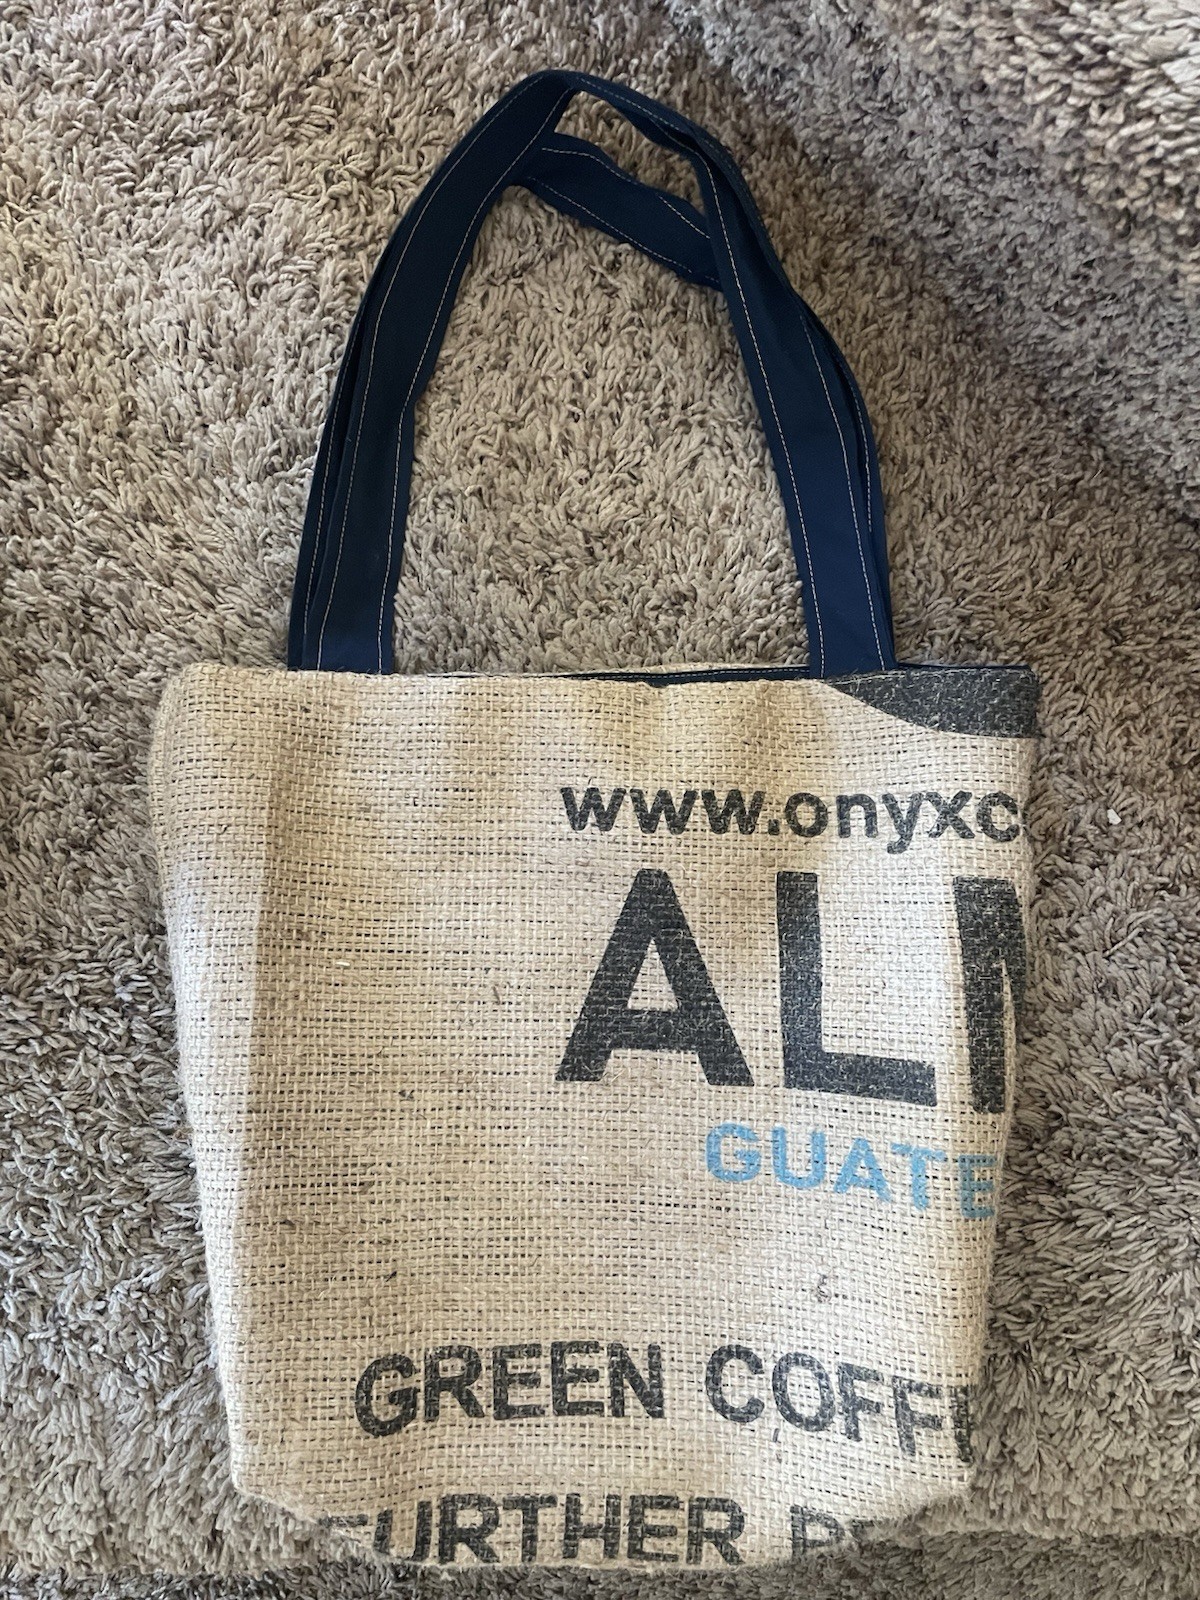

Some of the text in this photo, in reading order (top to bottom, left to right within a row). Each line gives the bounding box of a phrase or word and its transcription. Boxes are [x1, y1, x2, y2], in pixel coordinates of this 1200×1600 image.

[561, 786, 1022, 854] www.onyxc
[706, 1123, 996, 1219] GUATE
[354, 1341, 665, 1436] GREEN
[318, 1493, 746, 1565] URTHER
